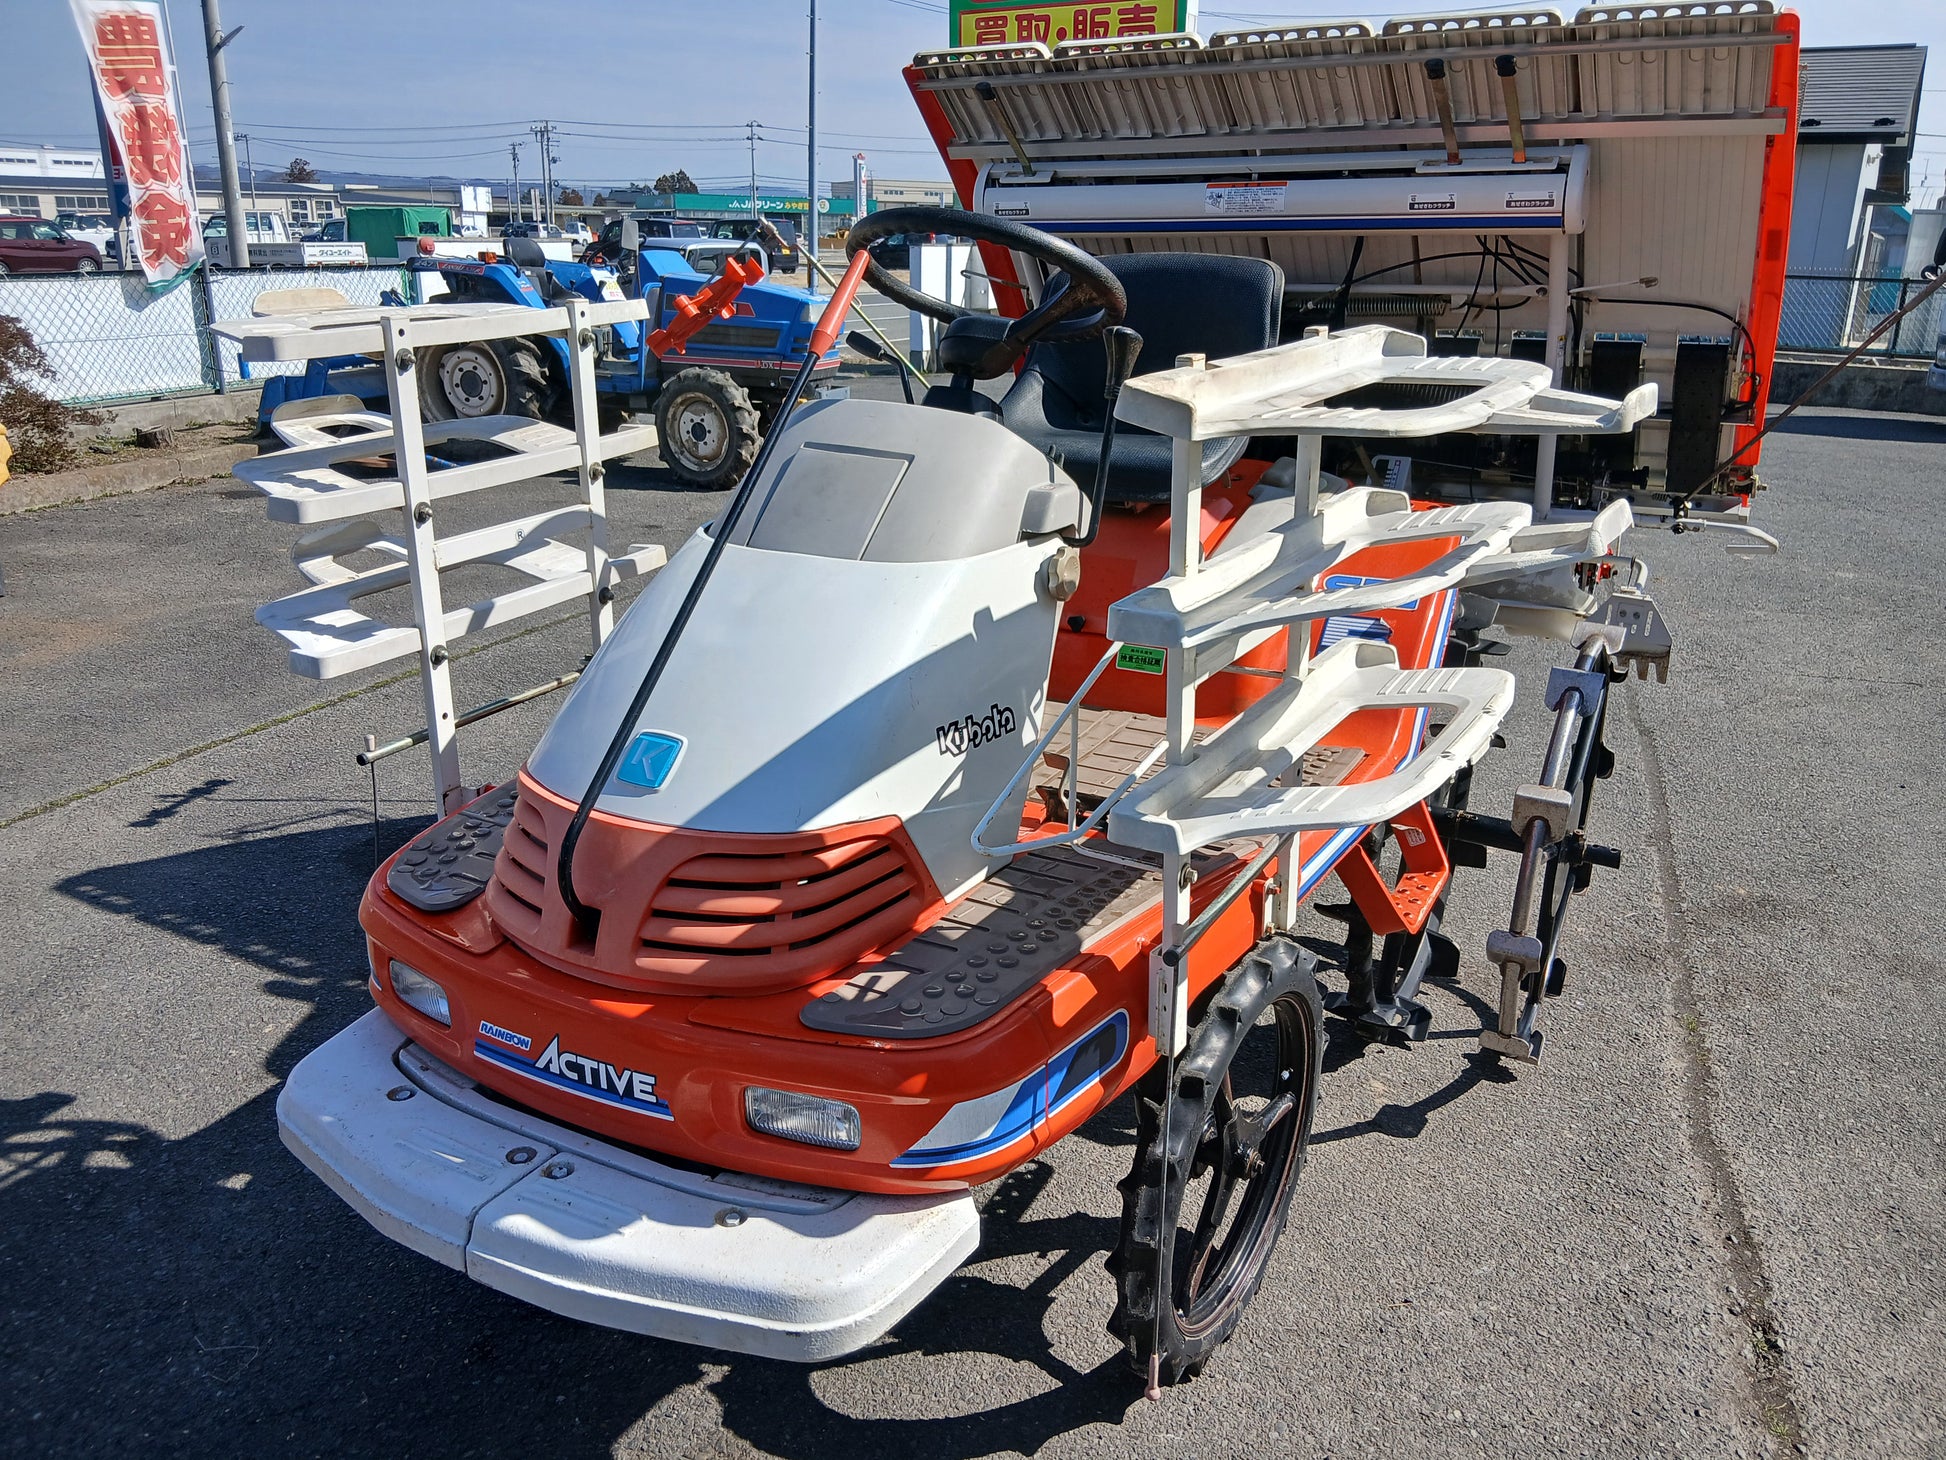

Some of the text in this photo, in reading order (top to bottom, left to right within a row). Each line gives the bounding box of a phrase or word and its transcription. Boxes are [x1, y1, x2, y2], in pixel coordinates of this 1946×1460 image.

[936, 703, 1016, 757] Kubota
[479, 1020, 531, 1050] RAINBOW
[534, 1035, 658, 1103] ACTIVE
